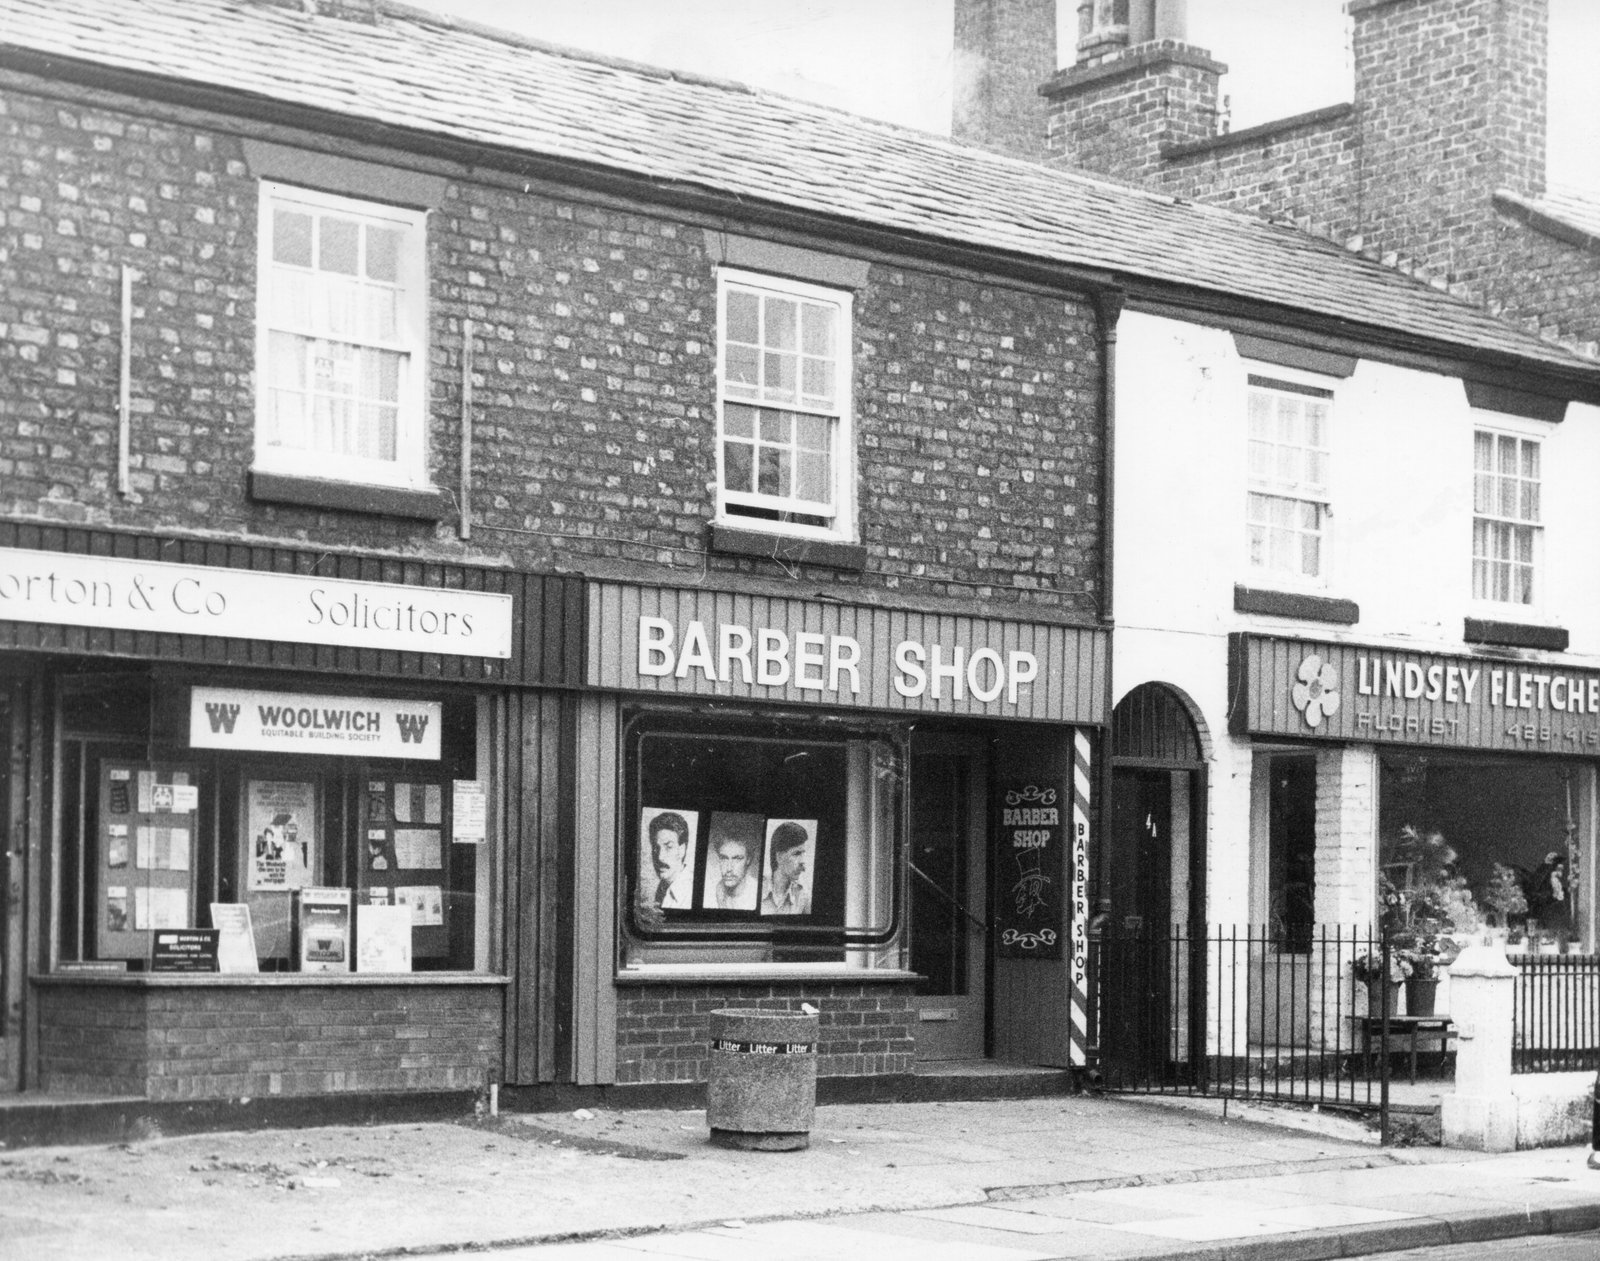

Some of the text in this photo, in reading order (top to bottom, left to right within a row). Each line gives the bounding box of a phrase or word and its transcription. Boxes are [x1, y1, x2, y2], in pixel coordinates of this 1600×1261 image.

[128, 574, 155, 611] &
[172, 577, 226, 616] Co
[308, 588, 473, 637] Solicitors
[638, 615, 1039, 704] BARBER SHOP
[1358, 657, 1600, 714] LINDSEY FLETCHE
[258, 705, 381, 732] WOOLWICH
[1358, 711, 1460, 735] FLORIST
[260, 728, 381, 742] EQUITABLE BUILDING SOCIETY
[1003, 807, 1059, 826] BARBER
[1013, 829, 1051, 848] SHOP
[1075, 823, 1085, 915] BARBER
[1075, 924, 1085, 985] SHOP
[719, 1039, 741, 1052] Litter
[749, 1042, 778, 1054] Litter
[786, 1042, 808, 1054] Litter
